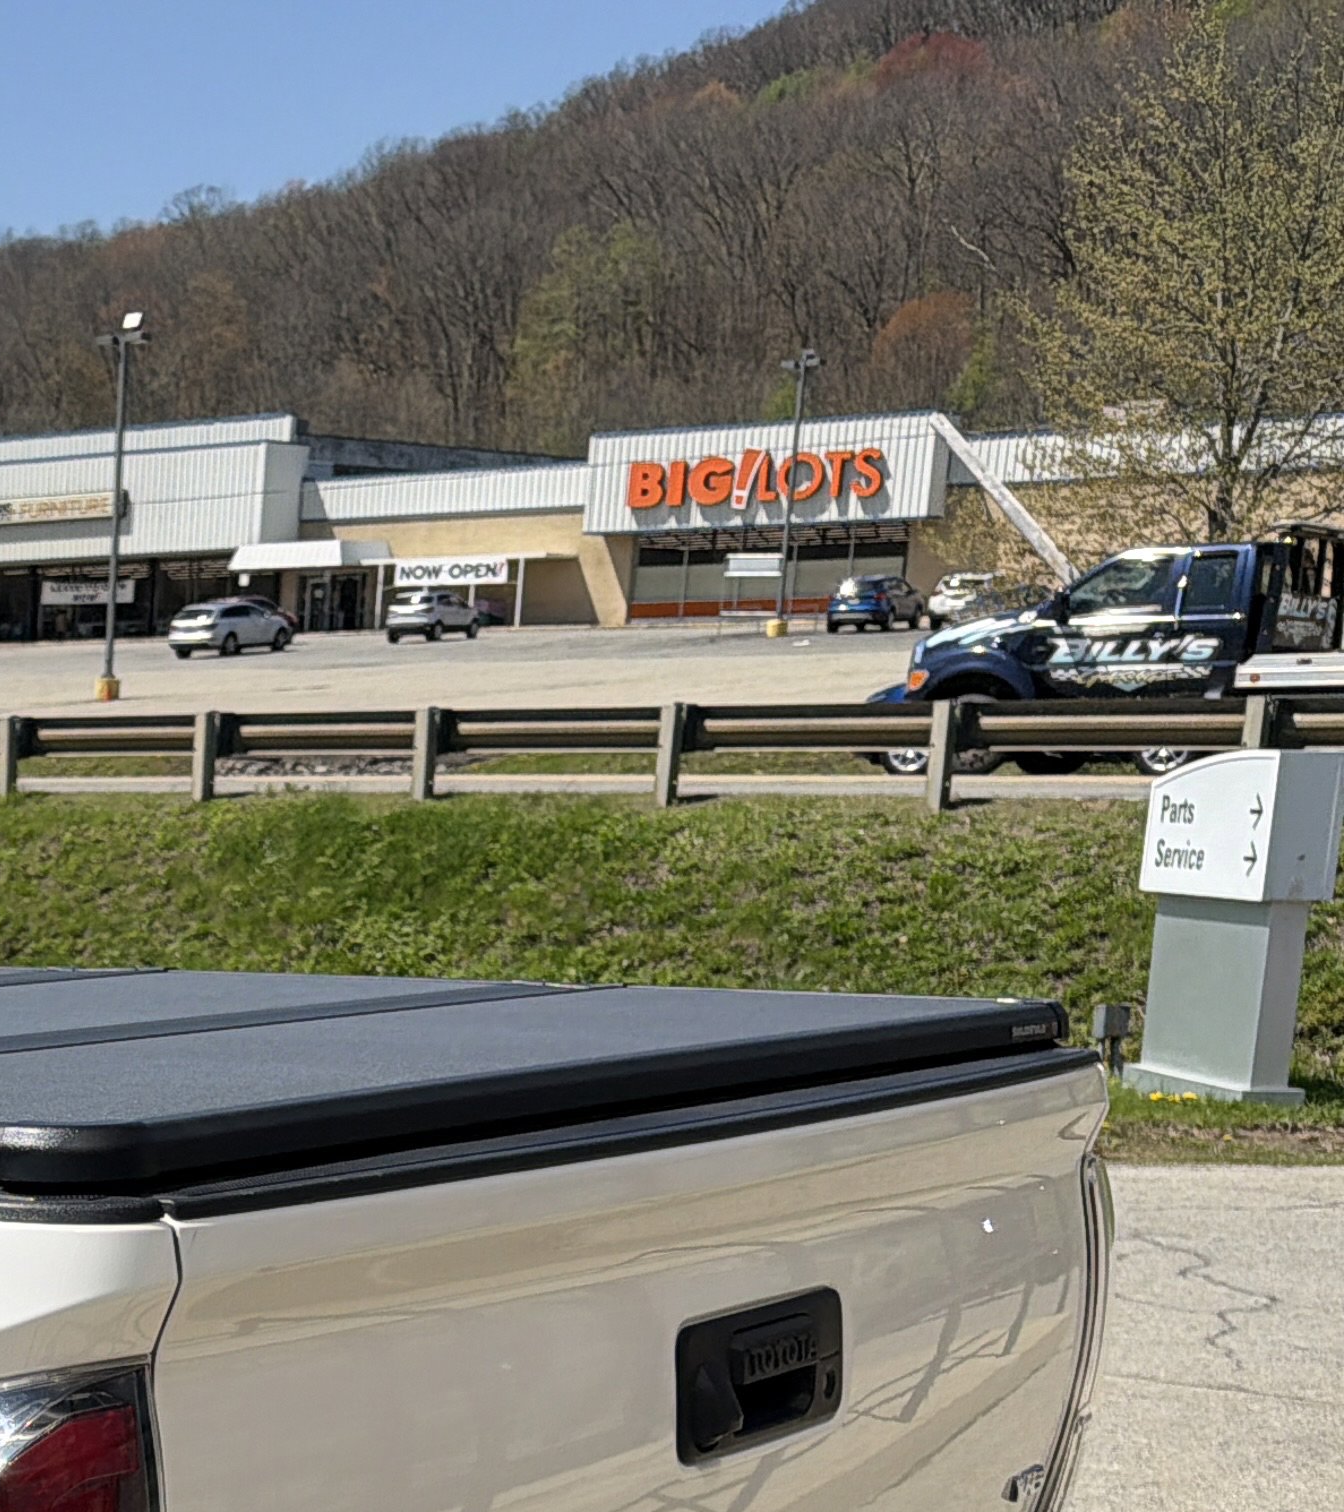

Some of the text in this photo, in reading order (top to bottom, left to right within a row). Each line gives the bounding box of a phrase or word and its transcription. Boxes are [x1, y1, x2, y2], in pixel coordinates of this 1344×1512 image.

[18, 497, 110, 519] FURNITURE
[400, 564, 443, 580] NOW
[1049, 634, 1220, 664] BILLY'S
[1160, 794, 1195, 824] Parts
[1154, 838, 1205, 870] Service
[744, 1332, 819, 1376] TOYOTA
